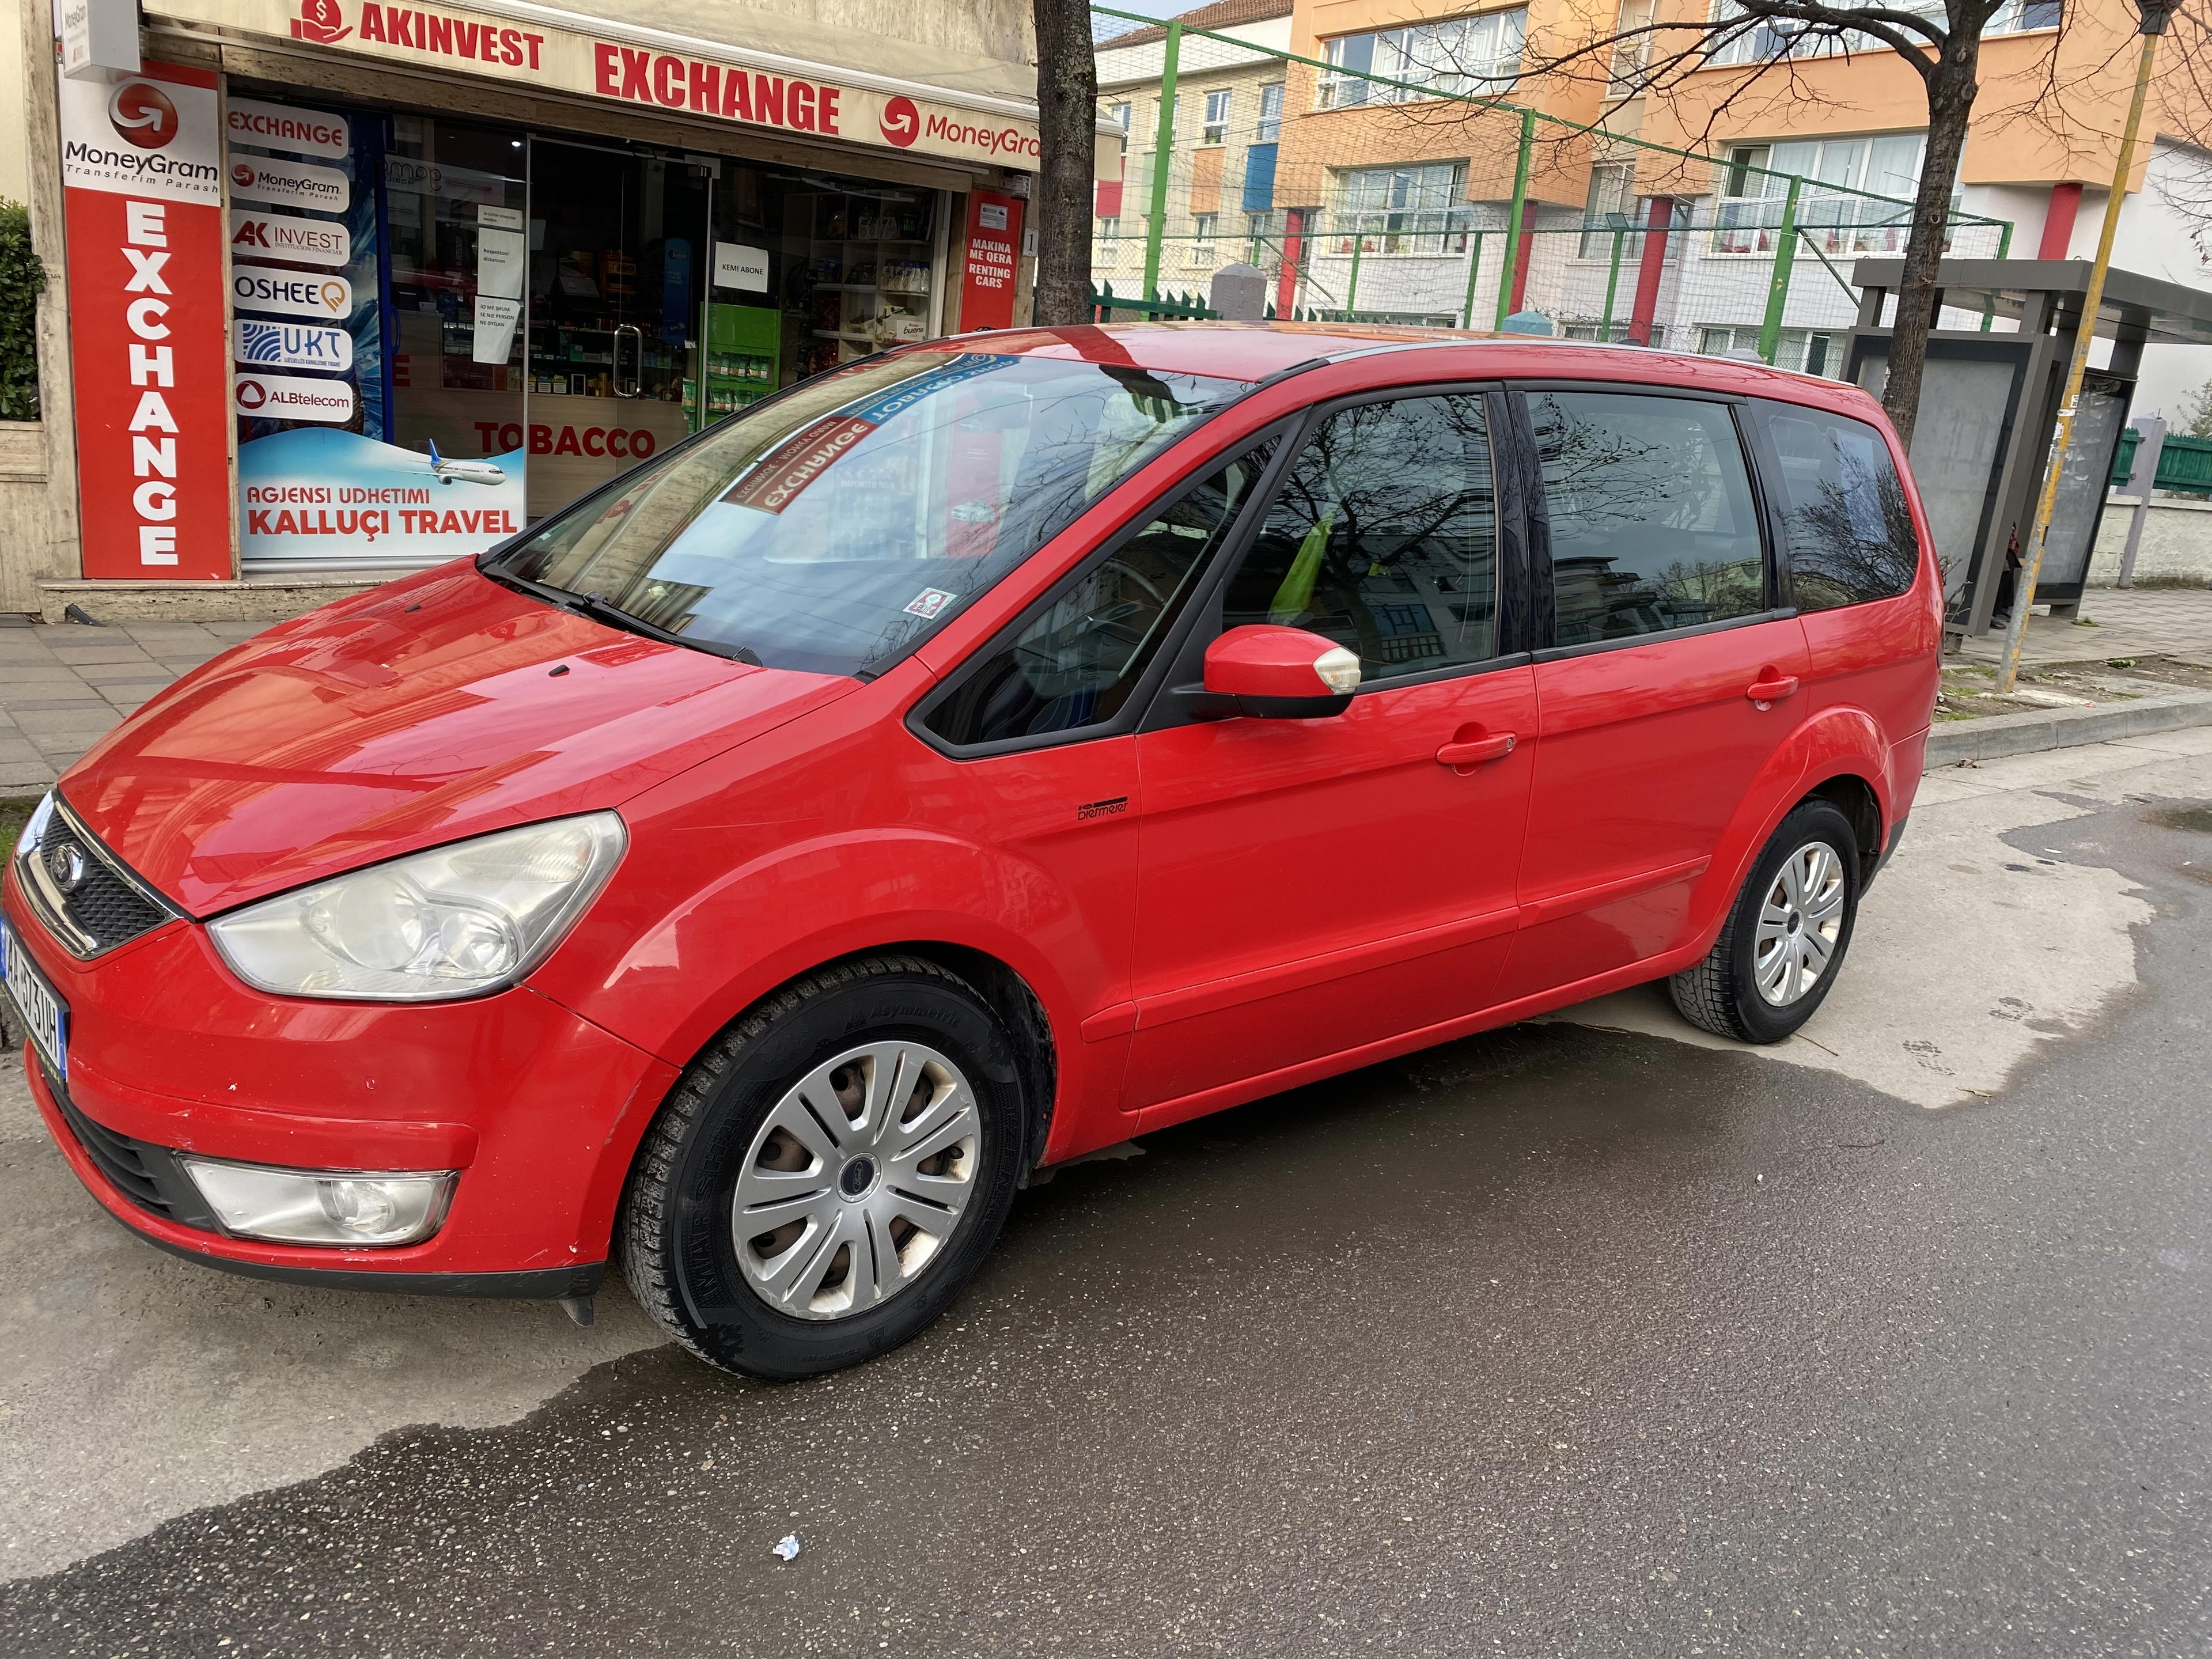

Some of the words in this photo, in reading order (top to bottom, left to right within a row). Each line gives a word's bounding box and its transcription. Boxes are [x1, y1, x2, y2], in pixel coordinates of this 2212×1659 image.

[360, 2, 543, 70] AKINVEST
[594, 42, 840, 135] EXCHANGE
[228, 111, 342, 147] EXCHANGE
[926, 114, 1040, 157] MoneyGra
[66, 141, 218, 181] MoneyGram
[66, 164, 156, 184] Transferim
[166, 179, 218, 193] Parash
[257, 184, 305, 196] Transferim
[309, 192, 338, 201] Parash
[232, 220, 271, 249] AK
[275, 226, 343, 250] INVEST
[275, 242, 312, 252] INSTITUCION
[312, 247, 343, 256] FINANCIAR
[972, 238, 1011, 253] MAKINA
[722, 263, 739, 272] KEMI
[740, 266, 763, 275] ABONE
[969, 249, 983, 260] ME
[986, 251, 1012, 265] QERA
[969, 263, 1010, 279] RENTING
[234, 276, 319, 305] OSHEE
[975, 275, 1003, 289] CARS
[284, 327, 340, 358] UKT
[903, 325, 924, 335] bueno
[120, 200, 179, 566] EXCHANGE
[270, 391, 349, 408] ALBtelecom
[474, 421, 656, 459] TOBACCO
[247, 487, 331, 505] AGJENSI
[339, 487, 430, 505] UDHETIMI
[248, 509, 389, 542] KALLUÇI
[400, 509, 517, 535] TRAVEL
